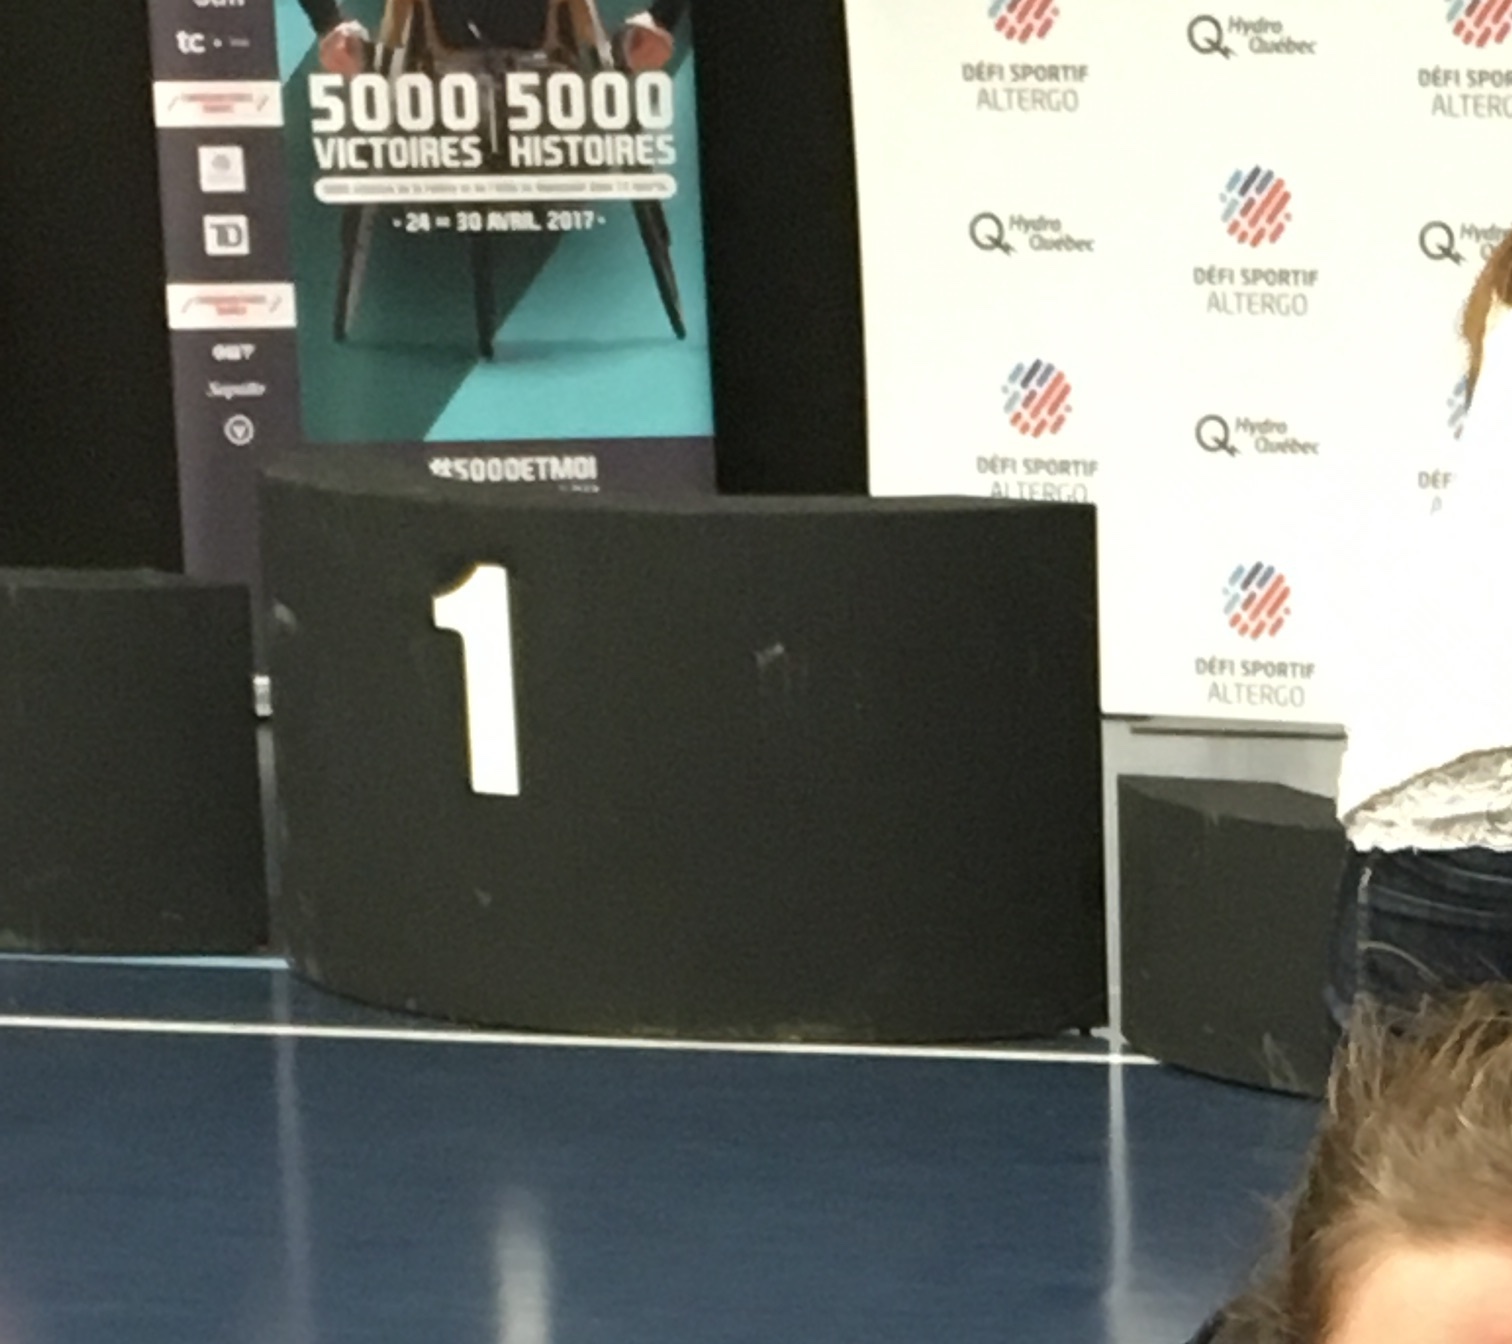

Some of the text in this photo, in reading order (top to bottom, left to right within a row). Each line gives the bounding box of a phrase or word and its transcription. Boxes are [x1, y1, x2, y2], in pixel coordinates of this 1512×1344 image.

[1227, 16, 1283, 36] Hydro
[1248, 35, 1316, 55] Québec
[961, 61, 1088, 83] DÉFI SPORTIF
[1418, 64, 1460, 88] DÉFI
[308, 70, 675, 133] 5000 5000
[976, 87, 1079, 112] ALTERGO
[313, 134, 677, 169] VICTOIRES HISTOIRES
[406, 212, 430, 233] 24
[456, 210, 482, 232] 30
[486, 210, 542, 232] AVRIL
[546, 210, 594, 232] 2017
[1008, 215, 1061, 236] Hydro
[1028, 235, 1095, 252] Québec
[1193, 265, 1319, 287] DÉFI SPORTIF
[1207, 291, 1308, 316] ALTERGO
[1235, 416, 1287, 437] Hydro
[1253, 436, 1319, 455] Québec
[976, 453, 1099, 477] DÉFI SPORTIF
[1195, 656, 1315, 679] DÉFI SPORTIF
[433, 563, 520, 796] 1
[1208, 681, 1305, 707] ALTERGO
